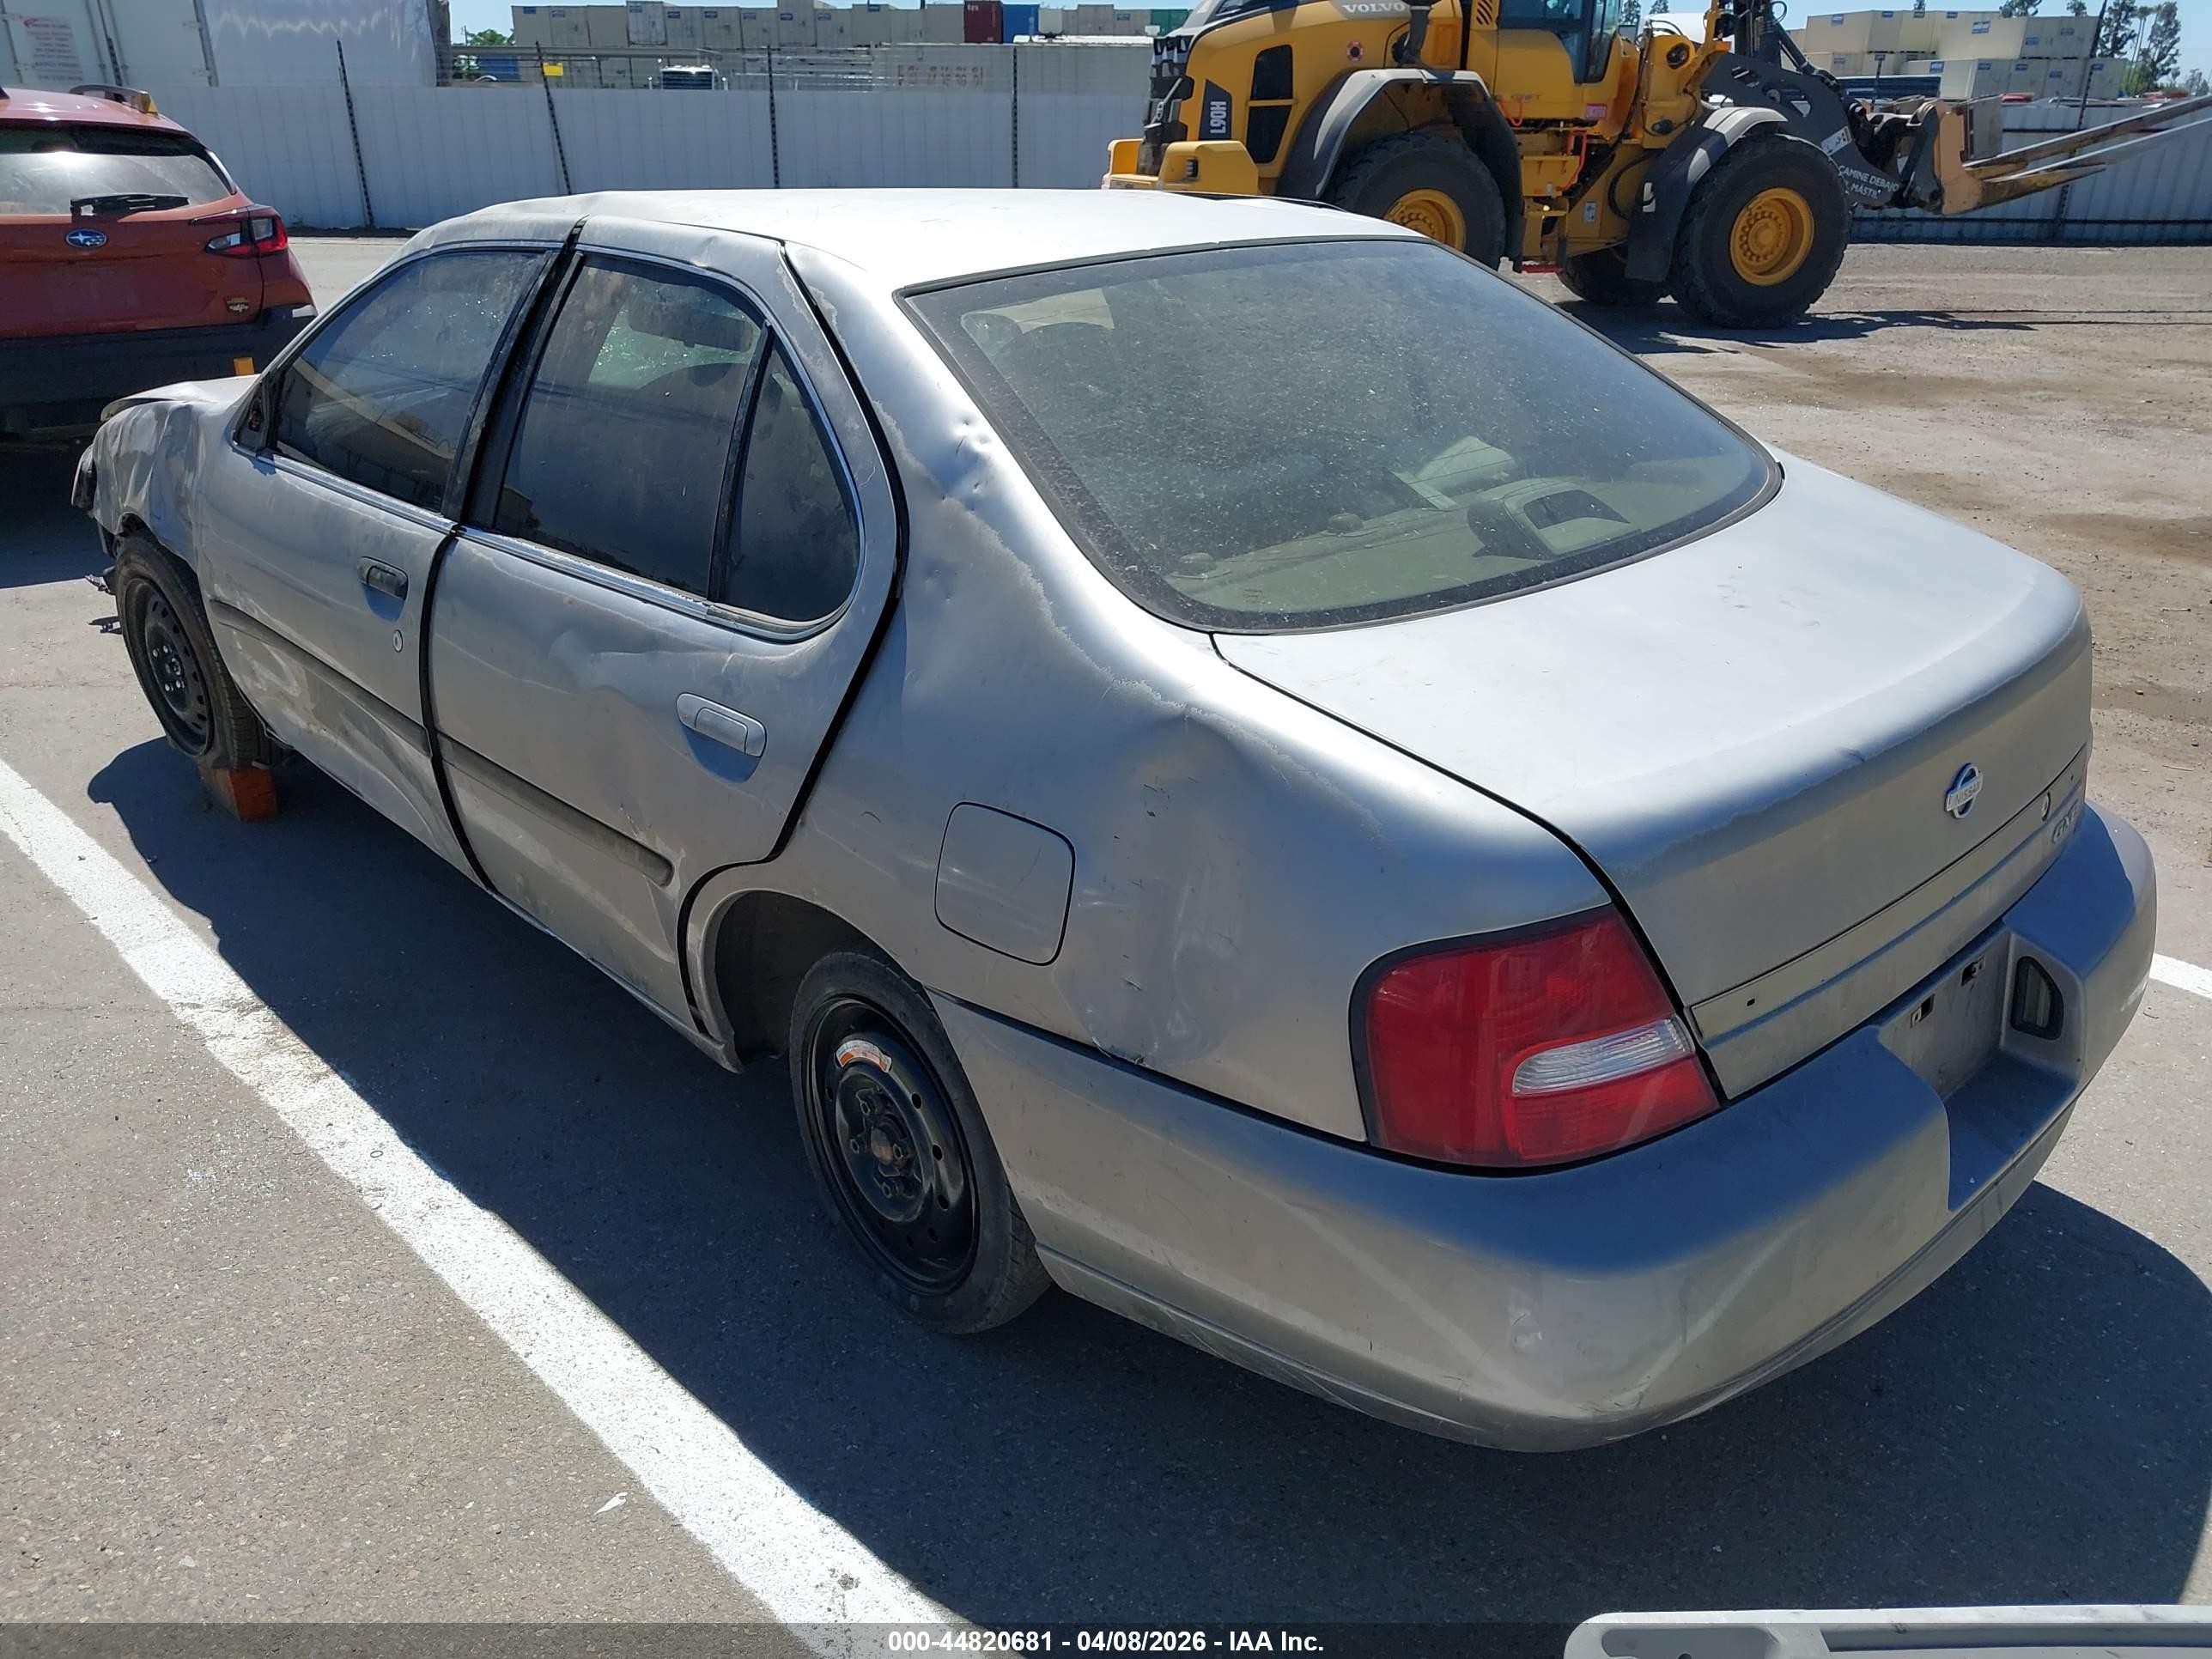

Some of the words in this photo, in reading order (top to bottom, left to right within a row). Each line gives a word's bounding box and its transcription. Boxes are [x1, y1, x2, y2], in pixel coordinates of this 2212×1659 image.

[1342, 3, 1406, 13] VOLVO
[1210, 101, 1226, 133] L90H
[1838, 165, 1870, 182] CAMINE
[1869, 175, 1899, 192] DEBAJO
[1954, 780, 1980, 807] NISSAN
